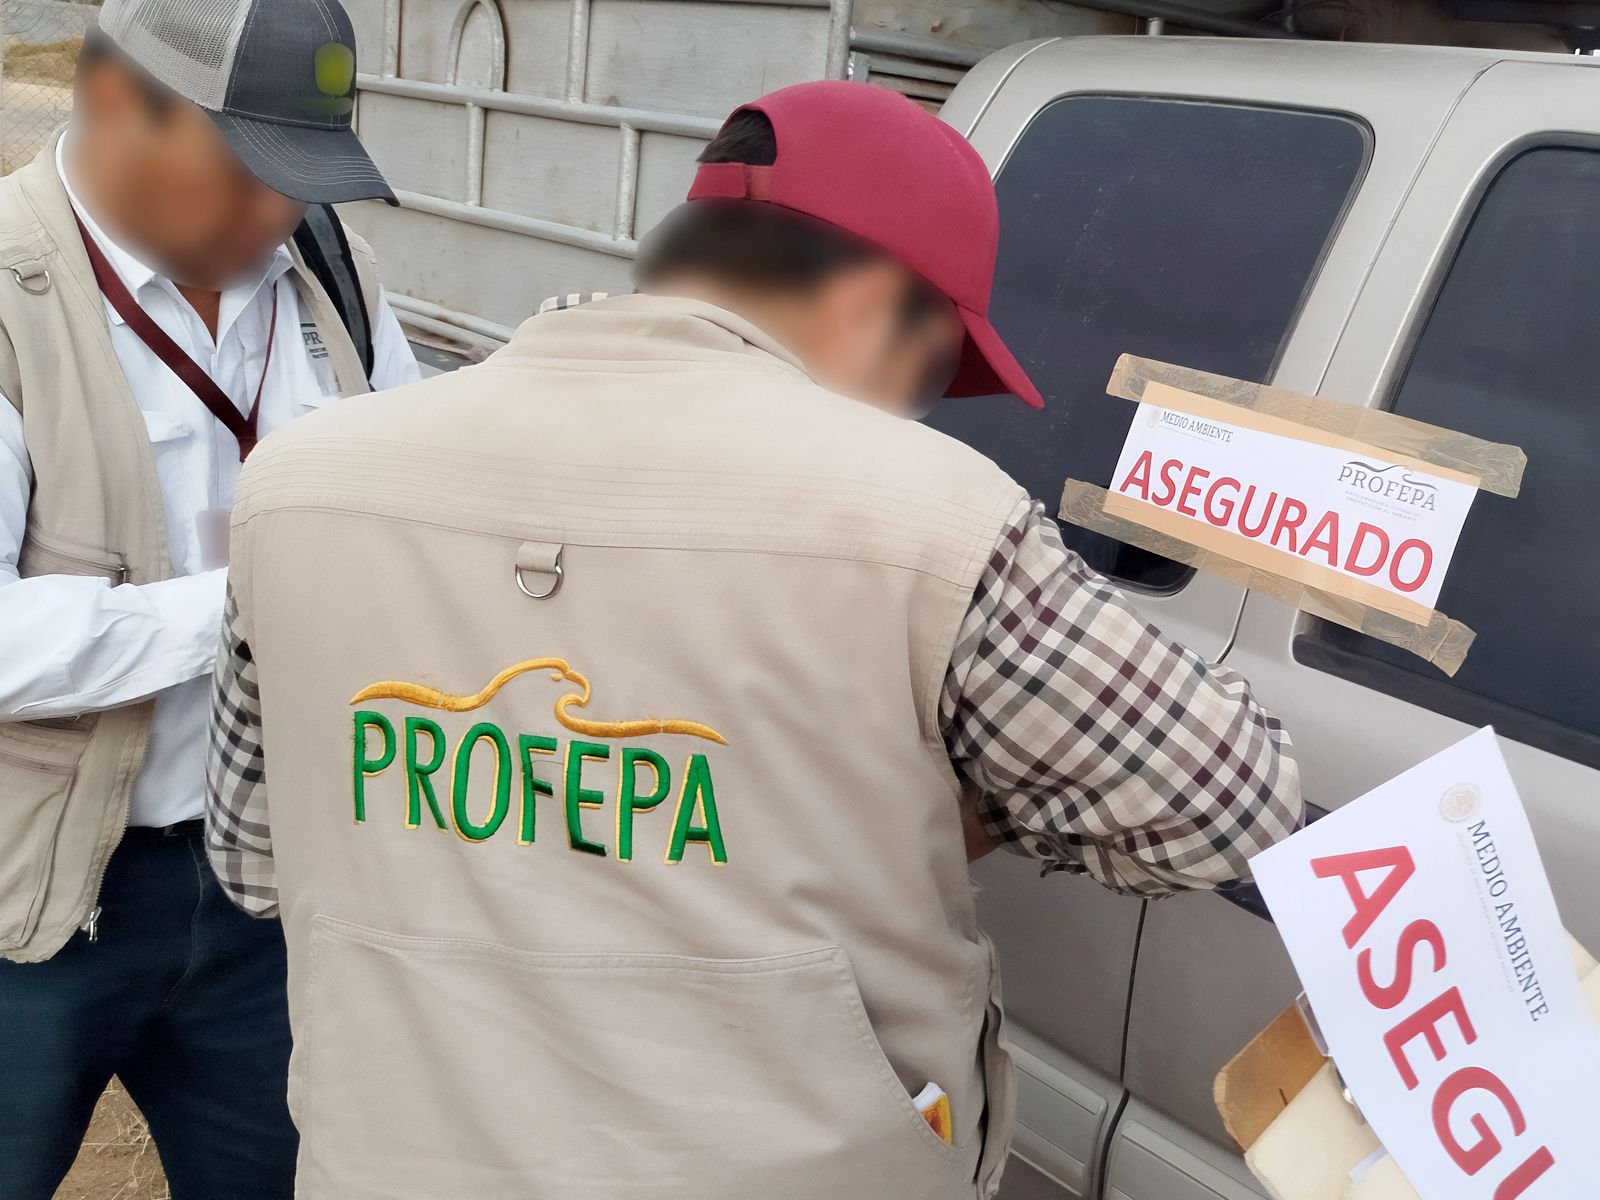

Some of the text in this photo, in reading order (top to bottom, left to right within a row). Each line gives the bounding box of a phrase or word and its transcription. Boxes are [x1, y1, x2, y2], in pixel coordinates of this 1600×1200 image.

[1160, 411, 1189, 429] MEDIO
[1187, 420, 1234, 443] AMBIENTE
[1337, 465, 1436, 511] PROFEPA
[1119, 450, 1434, 593] ASEGURADO
[353, 710, 728, 866] PROFEPA
[1467, 819, 1508, 897] MEDIO
[1495, 902, 1549, 1021] AMBIENTE
